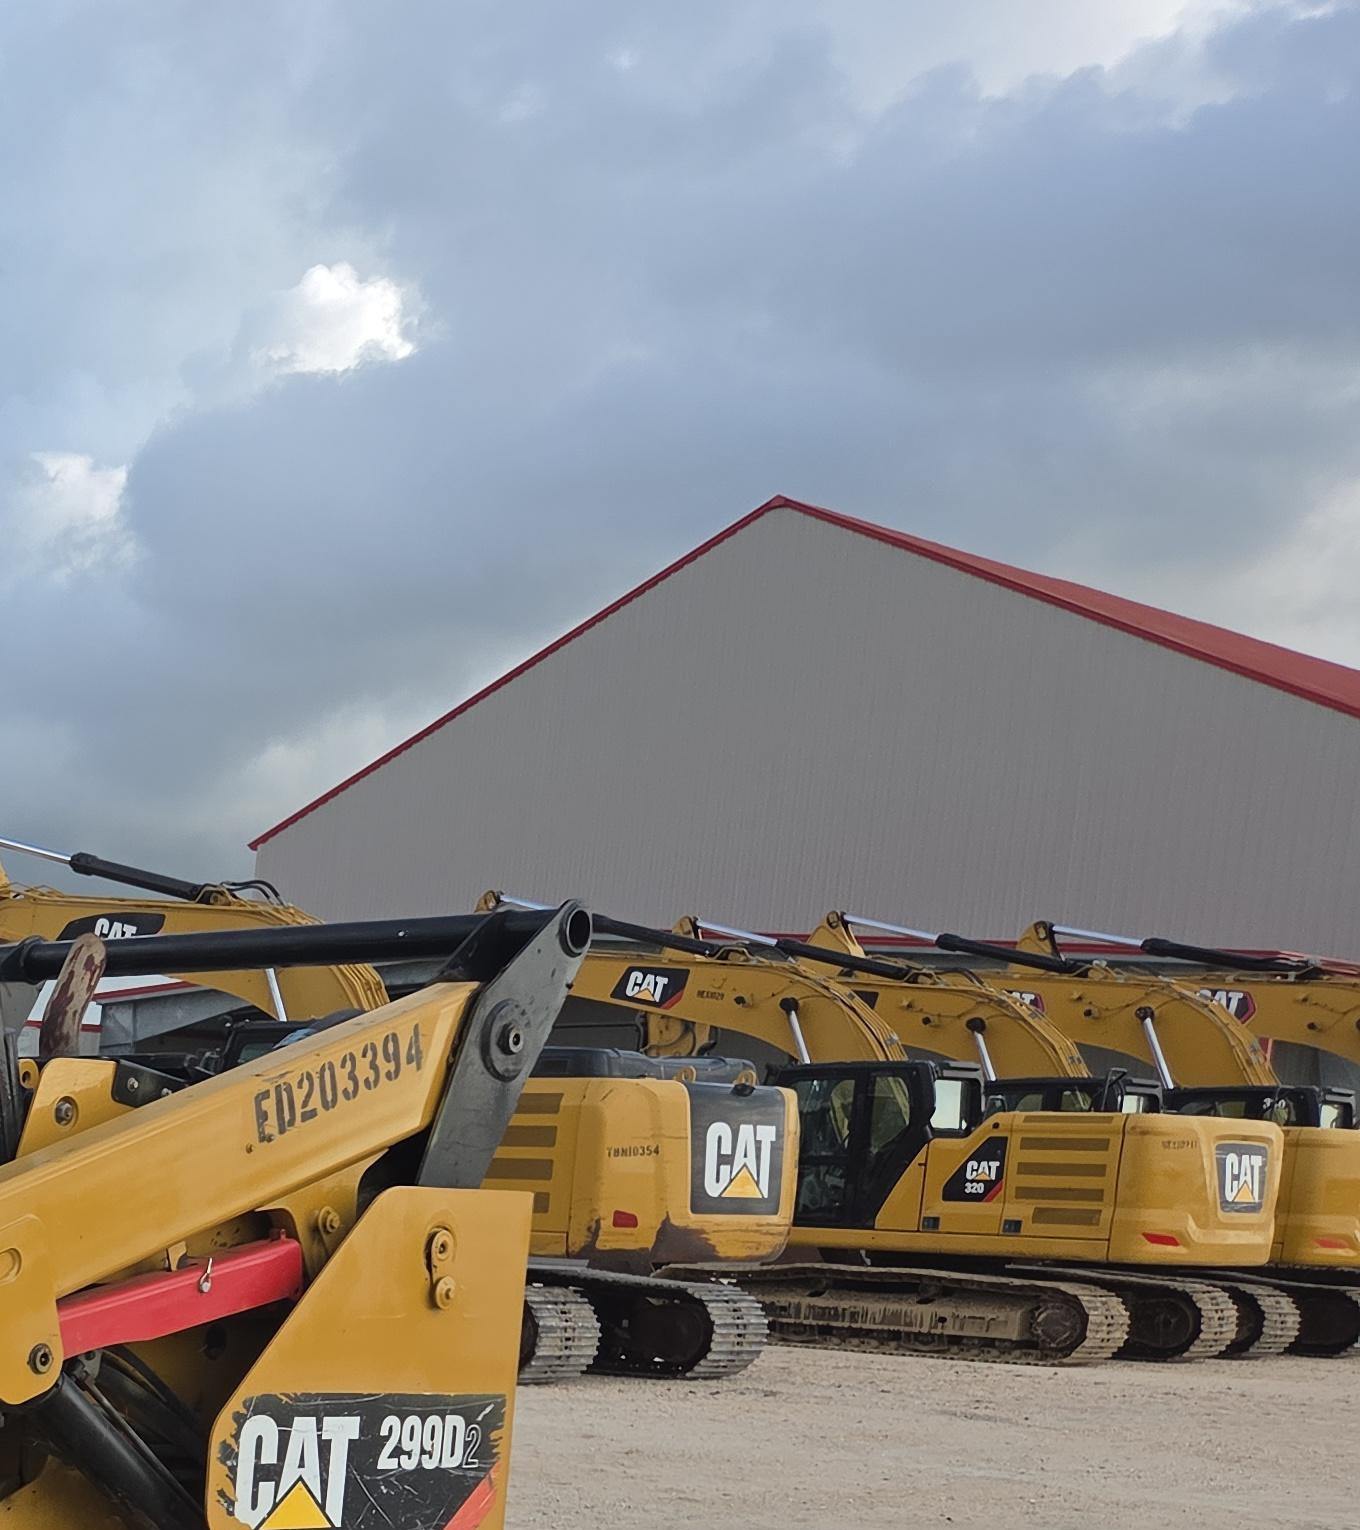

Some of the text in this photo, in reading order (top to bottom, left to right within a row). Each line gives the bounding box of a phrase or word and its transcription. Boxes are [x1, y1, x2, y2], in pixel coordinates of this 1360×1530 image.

[625, 971, 669, 1002] CAT
[254, 1023, 423, 1143] ED203394
[704, 1121, 776, 1199] CAT
[965, 1160, 1000, 1180] CAT
[1224, 1152, 1263, 1203] CAT
[964, 1182, 985, 1194] 320
[234, 1414, 482, 1530] CAT 299D2
